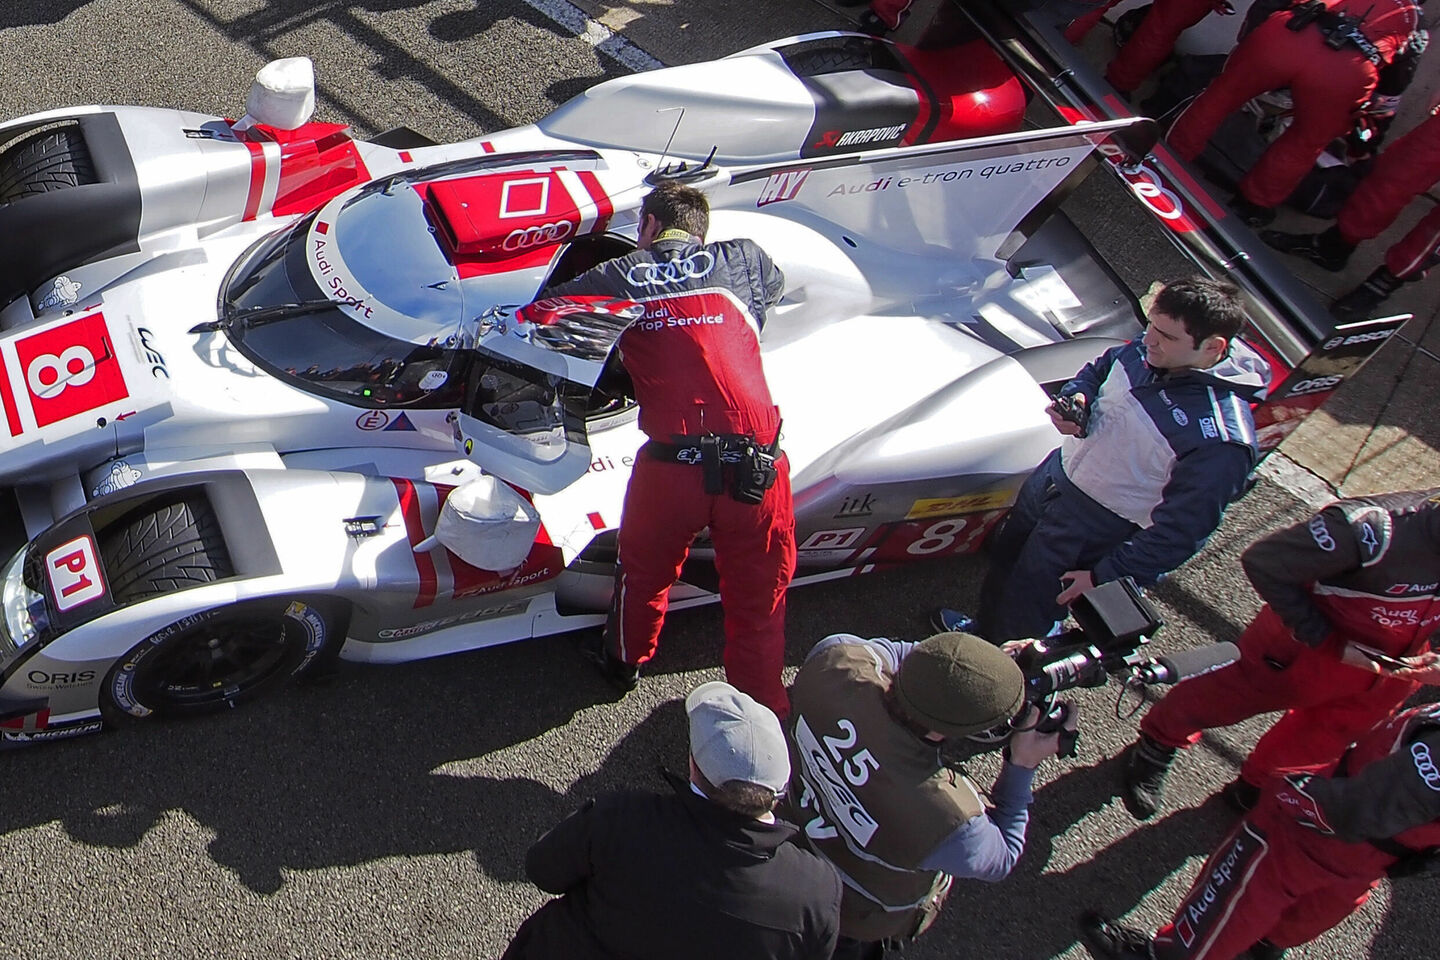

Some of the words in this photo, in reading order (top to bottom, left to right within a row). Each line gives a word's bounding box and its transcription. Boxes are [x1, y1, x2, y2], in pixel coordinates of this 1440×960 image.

[760, 170, 809, 204] HY
[827, 177, 892, 198] Audi
[898, 168, 973, 189] e-tron
[980, 155, 1071, 179] quattro
[315, 240, 334, 275] Audi
[328, 277, 374, 319] Sport
[639, 321, 664, 333] Top
[667, 313, 724, 328] Service
[137, 327, 169, 380] WEC
[28, 345, 96, 400] 8
[1291, 374, 1345, 392] ORIS
[839, 493, 877, 515] itk
[811, 530, 856, 546] P1
[906, 519, 968, 555] 8
[53, 548, 93, 599] P1
[1370, 613, 1402, 627] Top
[1372, 606, 1418, 620] Audi
[28, 670, 97, 684] ORIS
[33, 723, 100, 739] MICHELIN
[823, 719, 880, 787] 25
[1187, 882, 1218, 924] Audi
[1213, 840, 1244, 887] Sport
